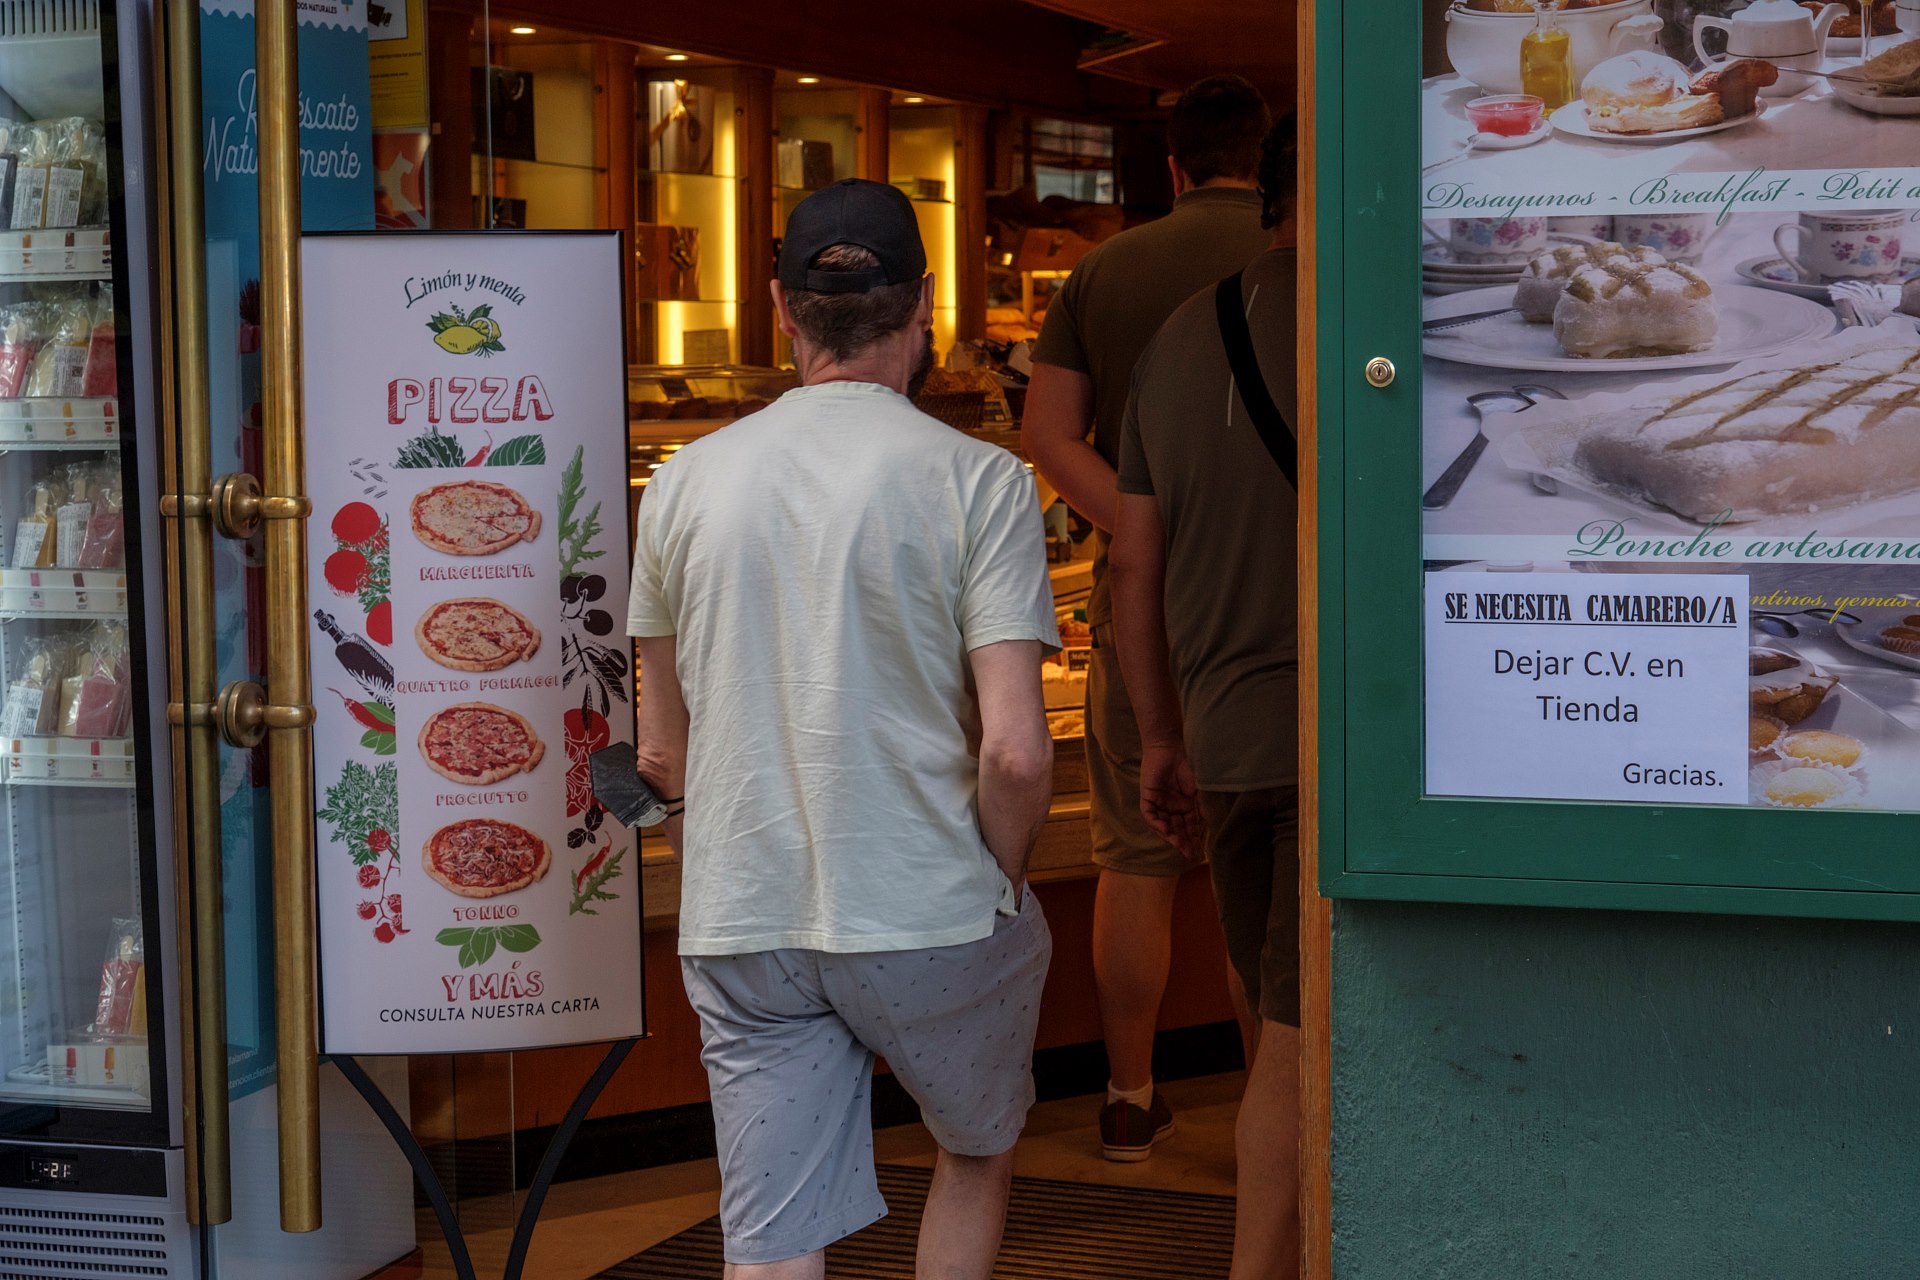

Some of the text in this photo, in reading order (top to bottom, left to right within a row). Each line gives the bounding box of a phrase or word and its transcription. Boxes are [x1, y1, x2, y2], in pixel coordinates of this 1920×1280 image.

[308, 4, 337, 14] NATURALES
[1422, 182, 1598, 223] Desayunos
[1629, 166, 1792, 226] Breakfast
[1816, 170, 1904, 201] Petit
[404, 269, 527, 309] Limón y menta
[388, 375, 554, 425] PIZZA
[1567, 507, 1734, 557] Ponche
[420, 563, 535, 581] MARGHERITA
[1444, 593, 1737, 624] SE NECESITA CAMARERO/A
[1828, 596, 1911, 625] yemas
[1494, 649, 1684, 681] Dejar C.V. en
[397, 675, 559, 694] QUATTRO FORMAGGI
[1536, 695, 1639, 723] Tienda
[1623, 762, 1724, 787] Gracias.
[436, 790, 529, 806] PROCIUTTO
[453, 905, 520, 921] TONNO
[441, 960, 545, 1003] Y MÁS
[379, 997, 600, 1022] CONSULTA NUESTRA CARTA
